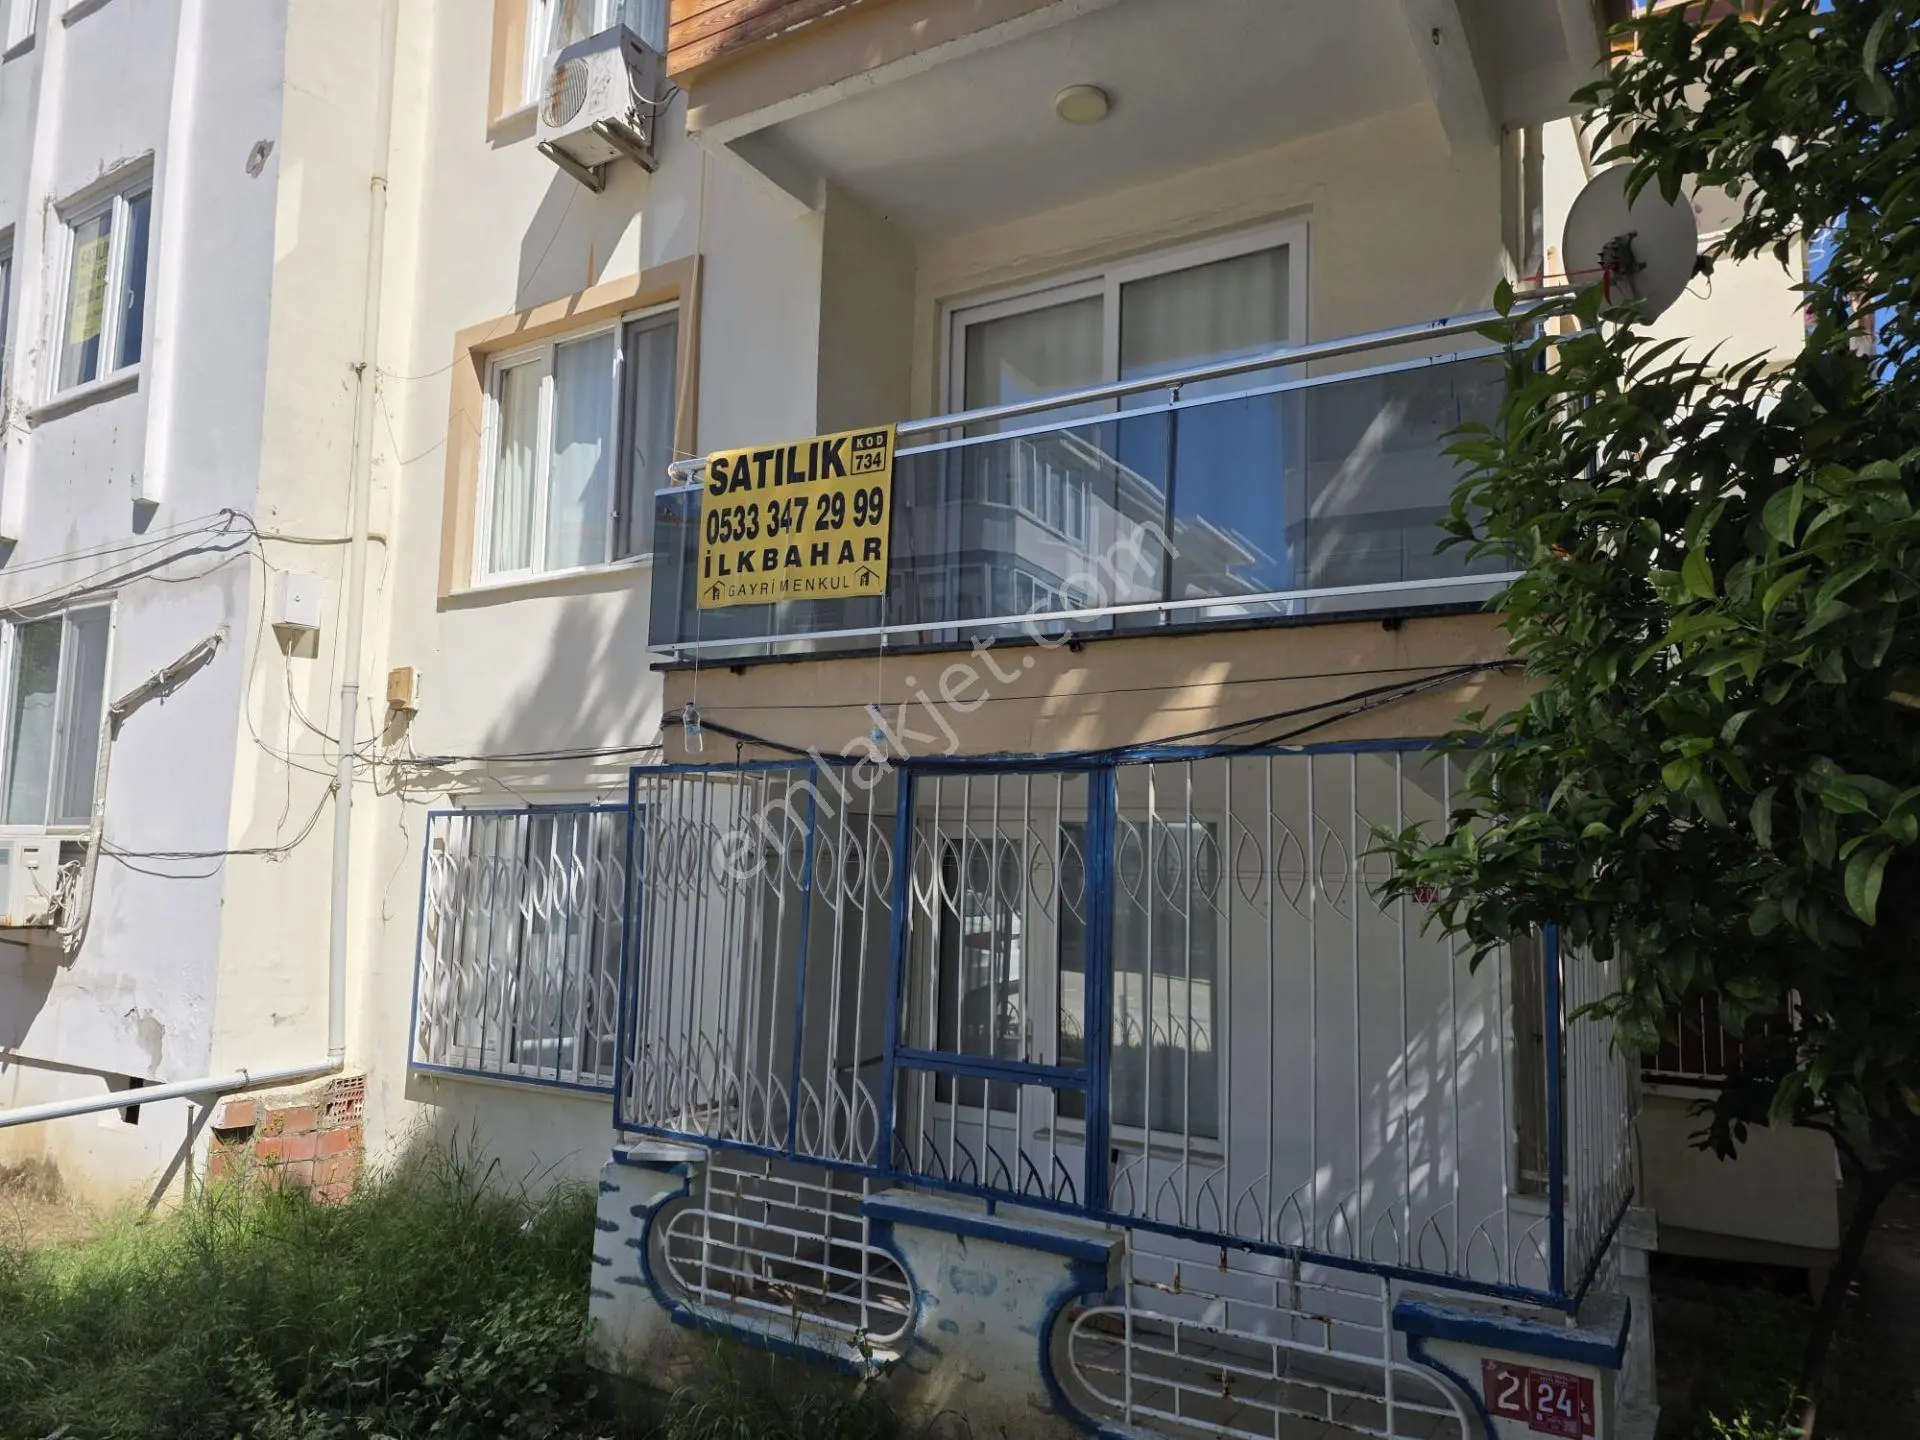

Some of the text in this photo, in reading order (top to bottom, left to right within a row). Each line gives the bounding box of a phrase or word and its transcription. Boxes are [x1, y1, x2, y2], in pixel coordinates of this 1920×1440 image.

[856, 434, 884, 448] KOD
[709, 438, 848, 496] SATILIK
[855, 452, 882, 471] 734
[706, 486, 884, 545] 0533 347 29 99
[704, 537, 882, 579] İLKBAHAR
[1537, 1383, 1572, 1418] 24
